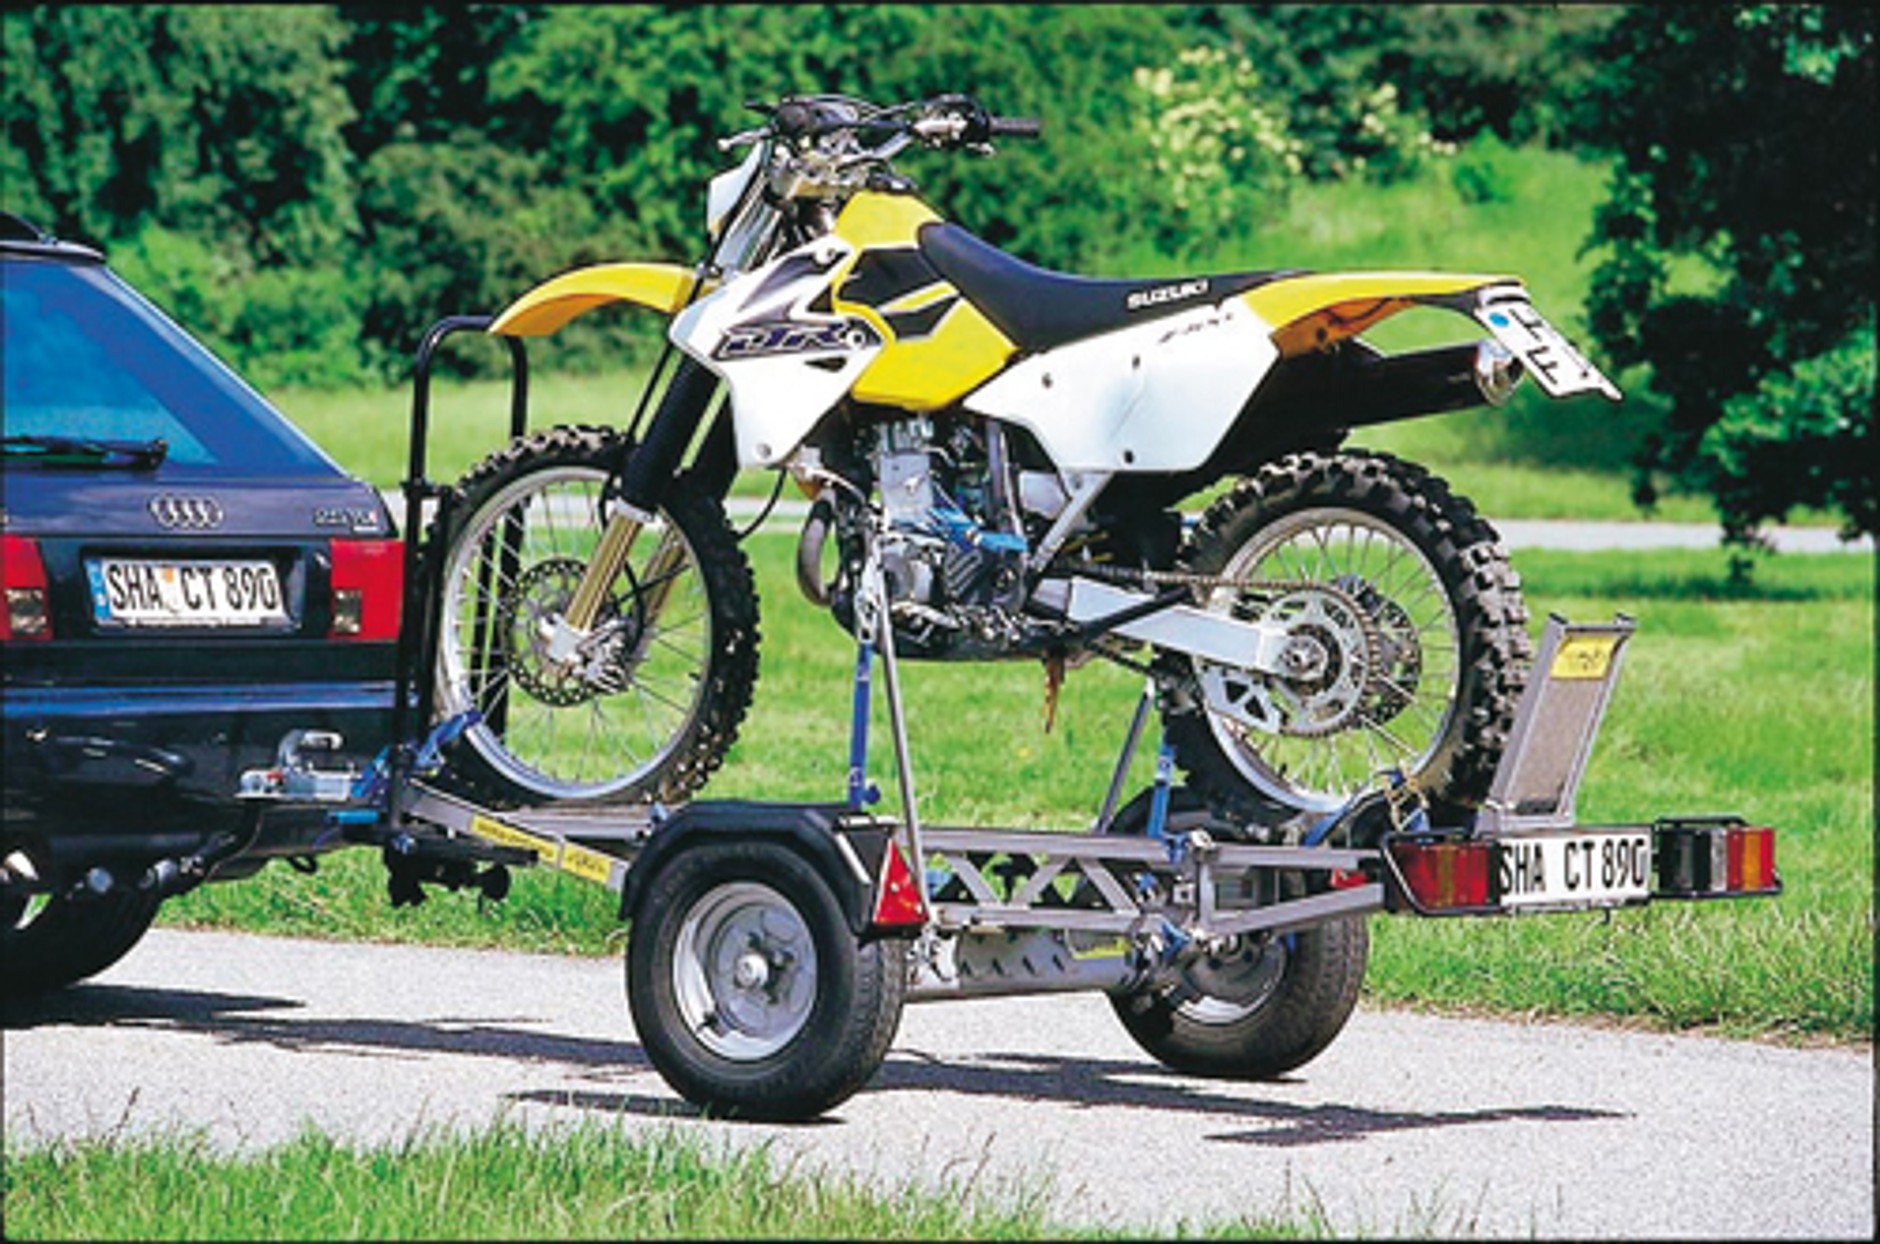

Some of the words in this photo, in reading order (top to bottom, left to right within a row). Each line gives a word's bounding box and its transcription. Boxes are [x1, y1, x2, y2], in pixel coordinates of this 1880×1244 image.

[1127, 278, 1209, 310] SUZUKI
[107, 563, 163, 610] SHA
[179, 566, 215, 610] CT
[222, 566, 277, 611] 890
[1499, 842, 1546, 895] SHA
[1564, 841, 1595, 890] CT
[1602, 838, 1648, 888] 890
